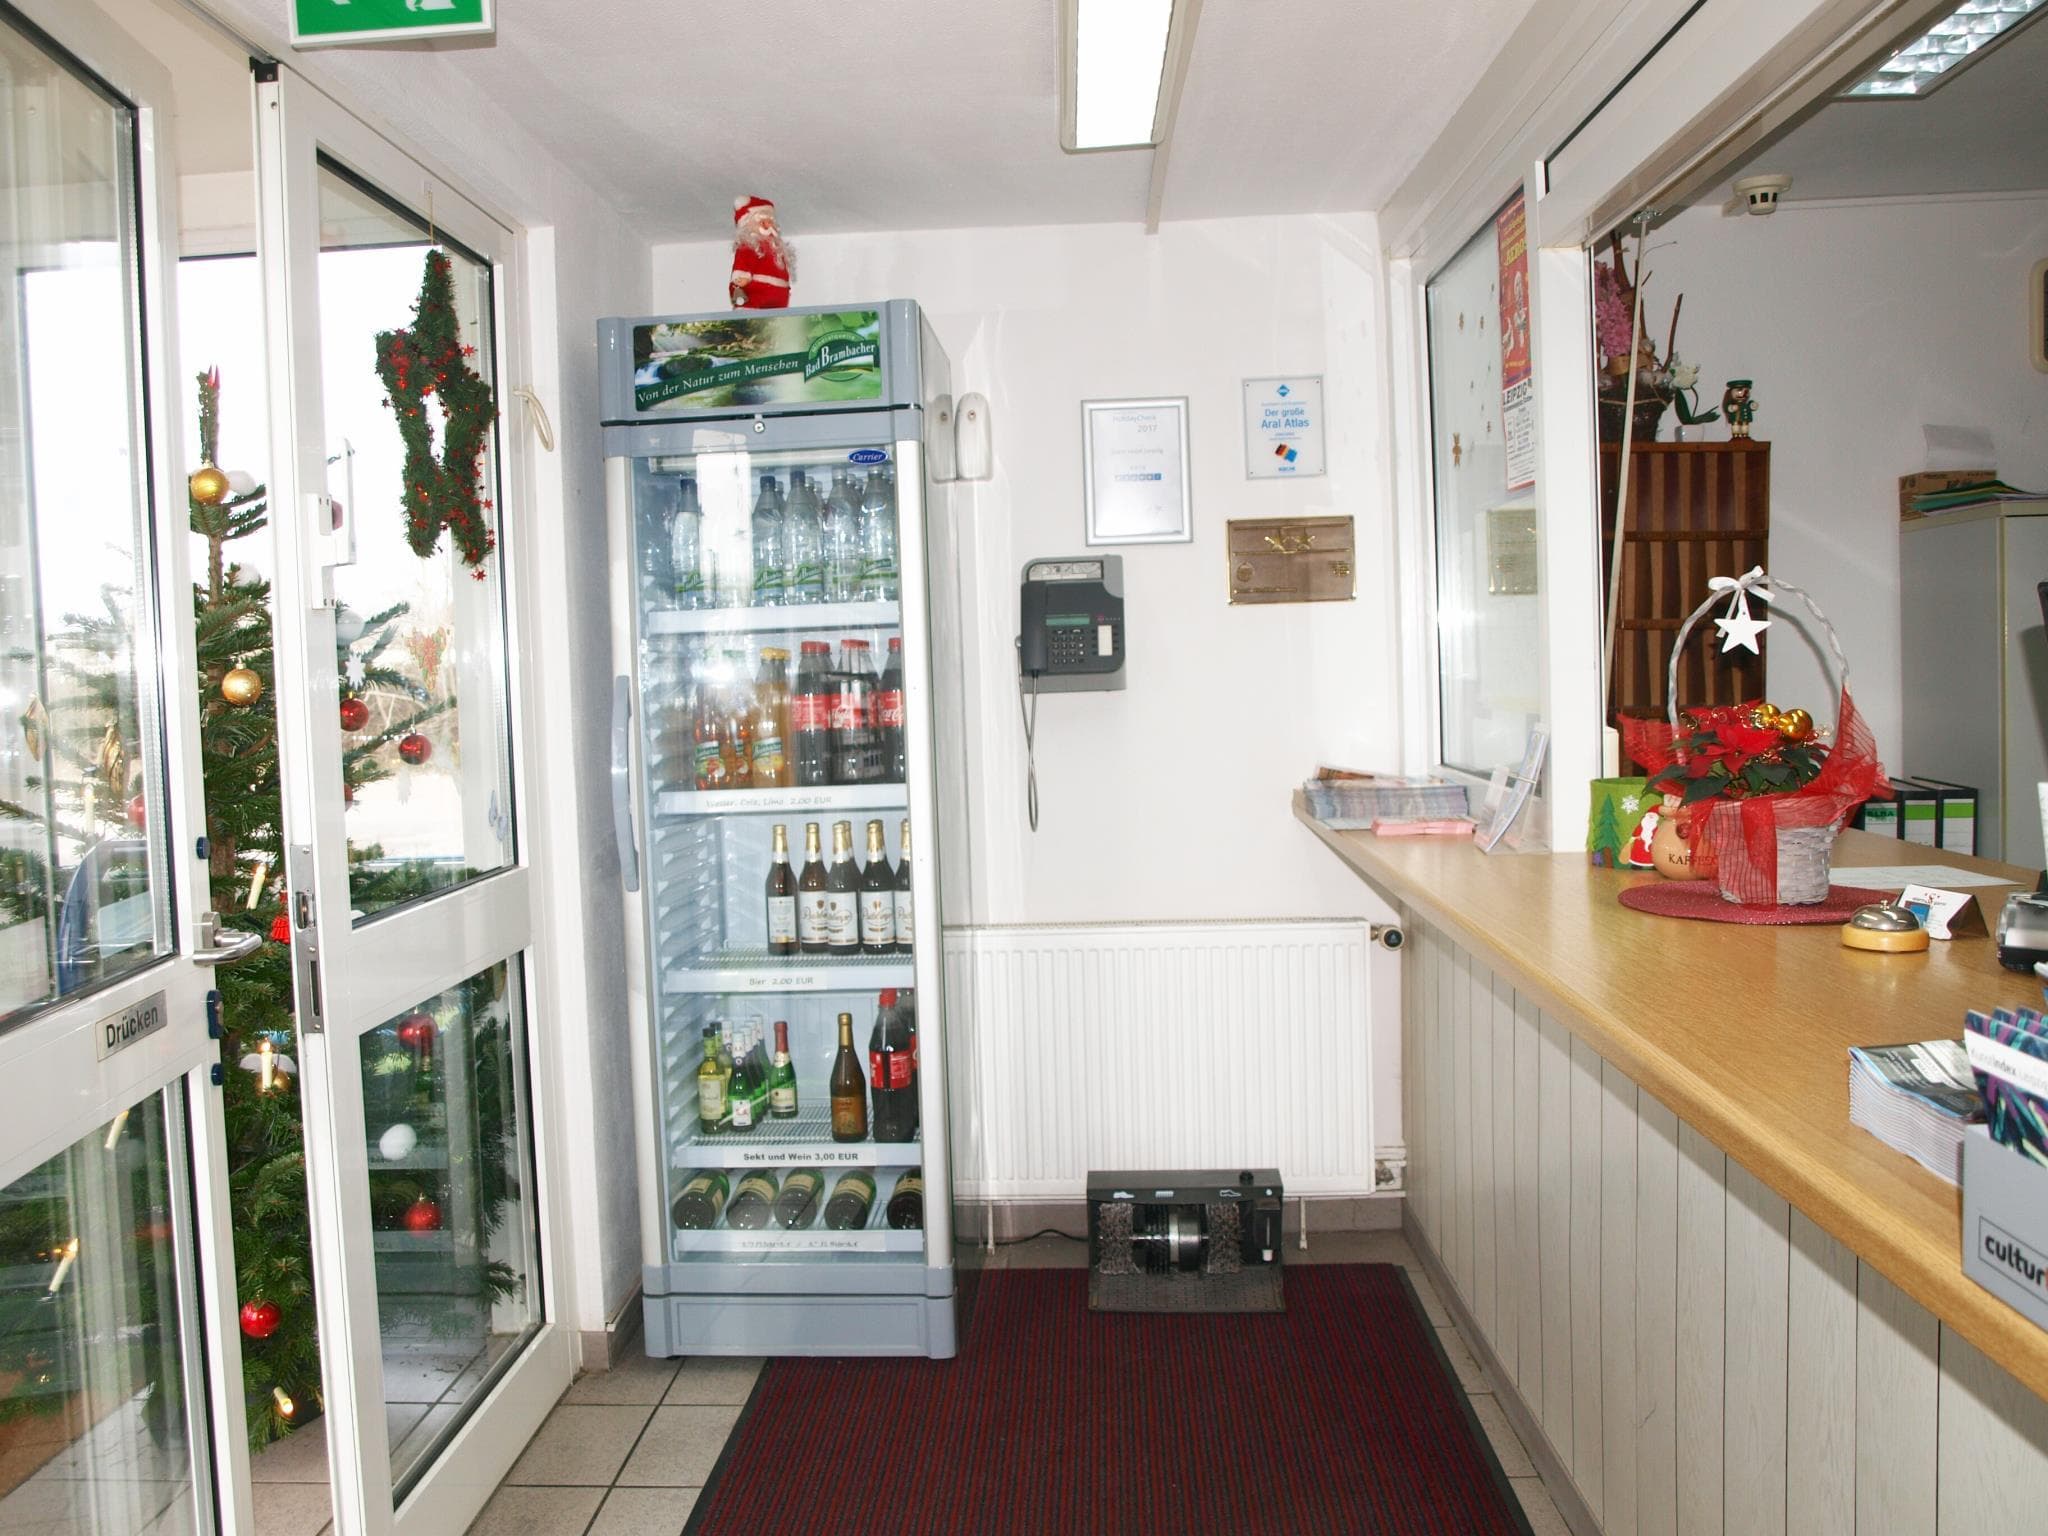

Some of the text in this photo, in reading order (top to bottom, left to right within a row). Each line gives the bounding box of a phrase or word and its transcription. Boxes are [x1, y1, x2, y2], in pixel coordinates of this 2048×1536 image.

[805, 342, 876, 377] Bad Brambacher
[637, 357, 799, 404] Von der Natur zum Menschen
[1502, 382, 1528, 406] LEIPZIG
[1264, 407, 1305, 418] Der große
[1136, 424, 1158, 433] 2017
[1261, 417, 1310, 429] Aral Atlas
[851, 451, 884, 463] Carrier
[813, 795, 832, 804] EUR
[795, 976, 814, 985] EUR
[106, 1007, 159, 1049] Drücken
[743, 1152, 859, 1162] Sekt und Wein 3,00 EUR
